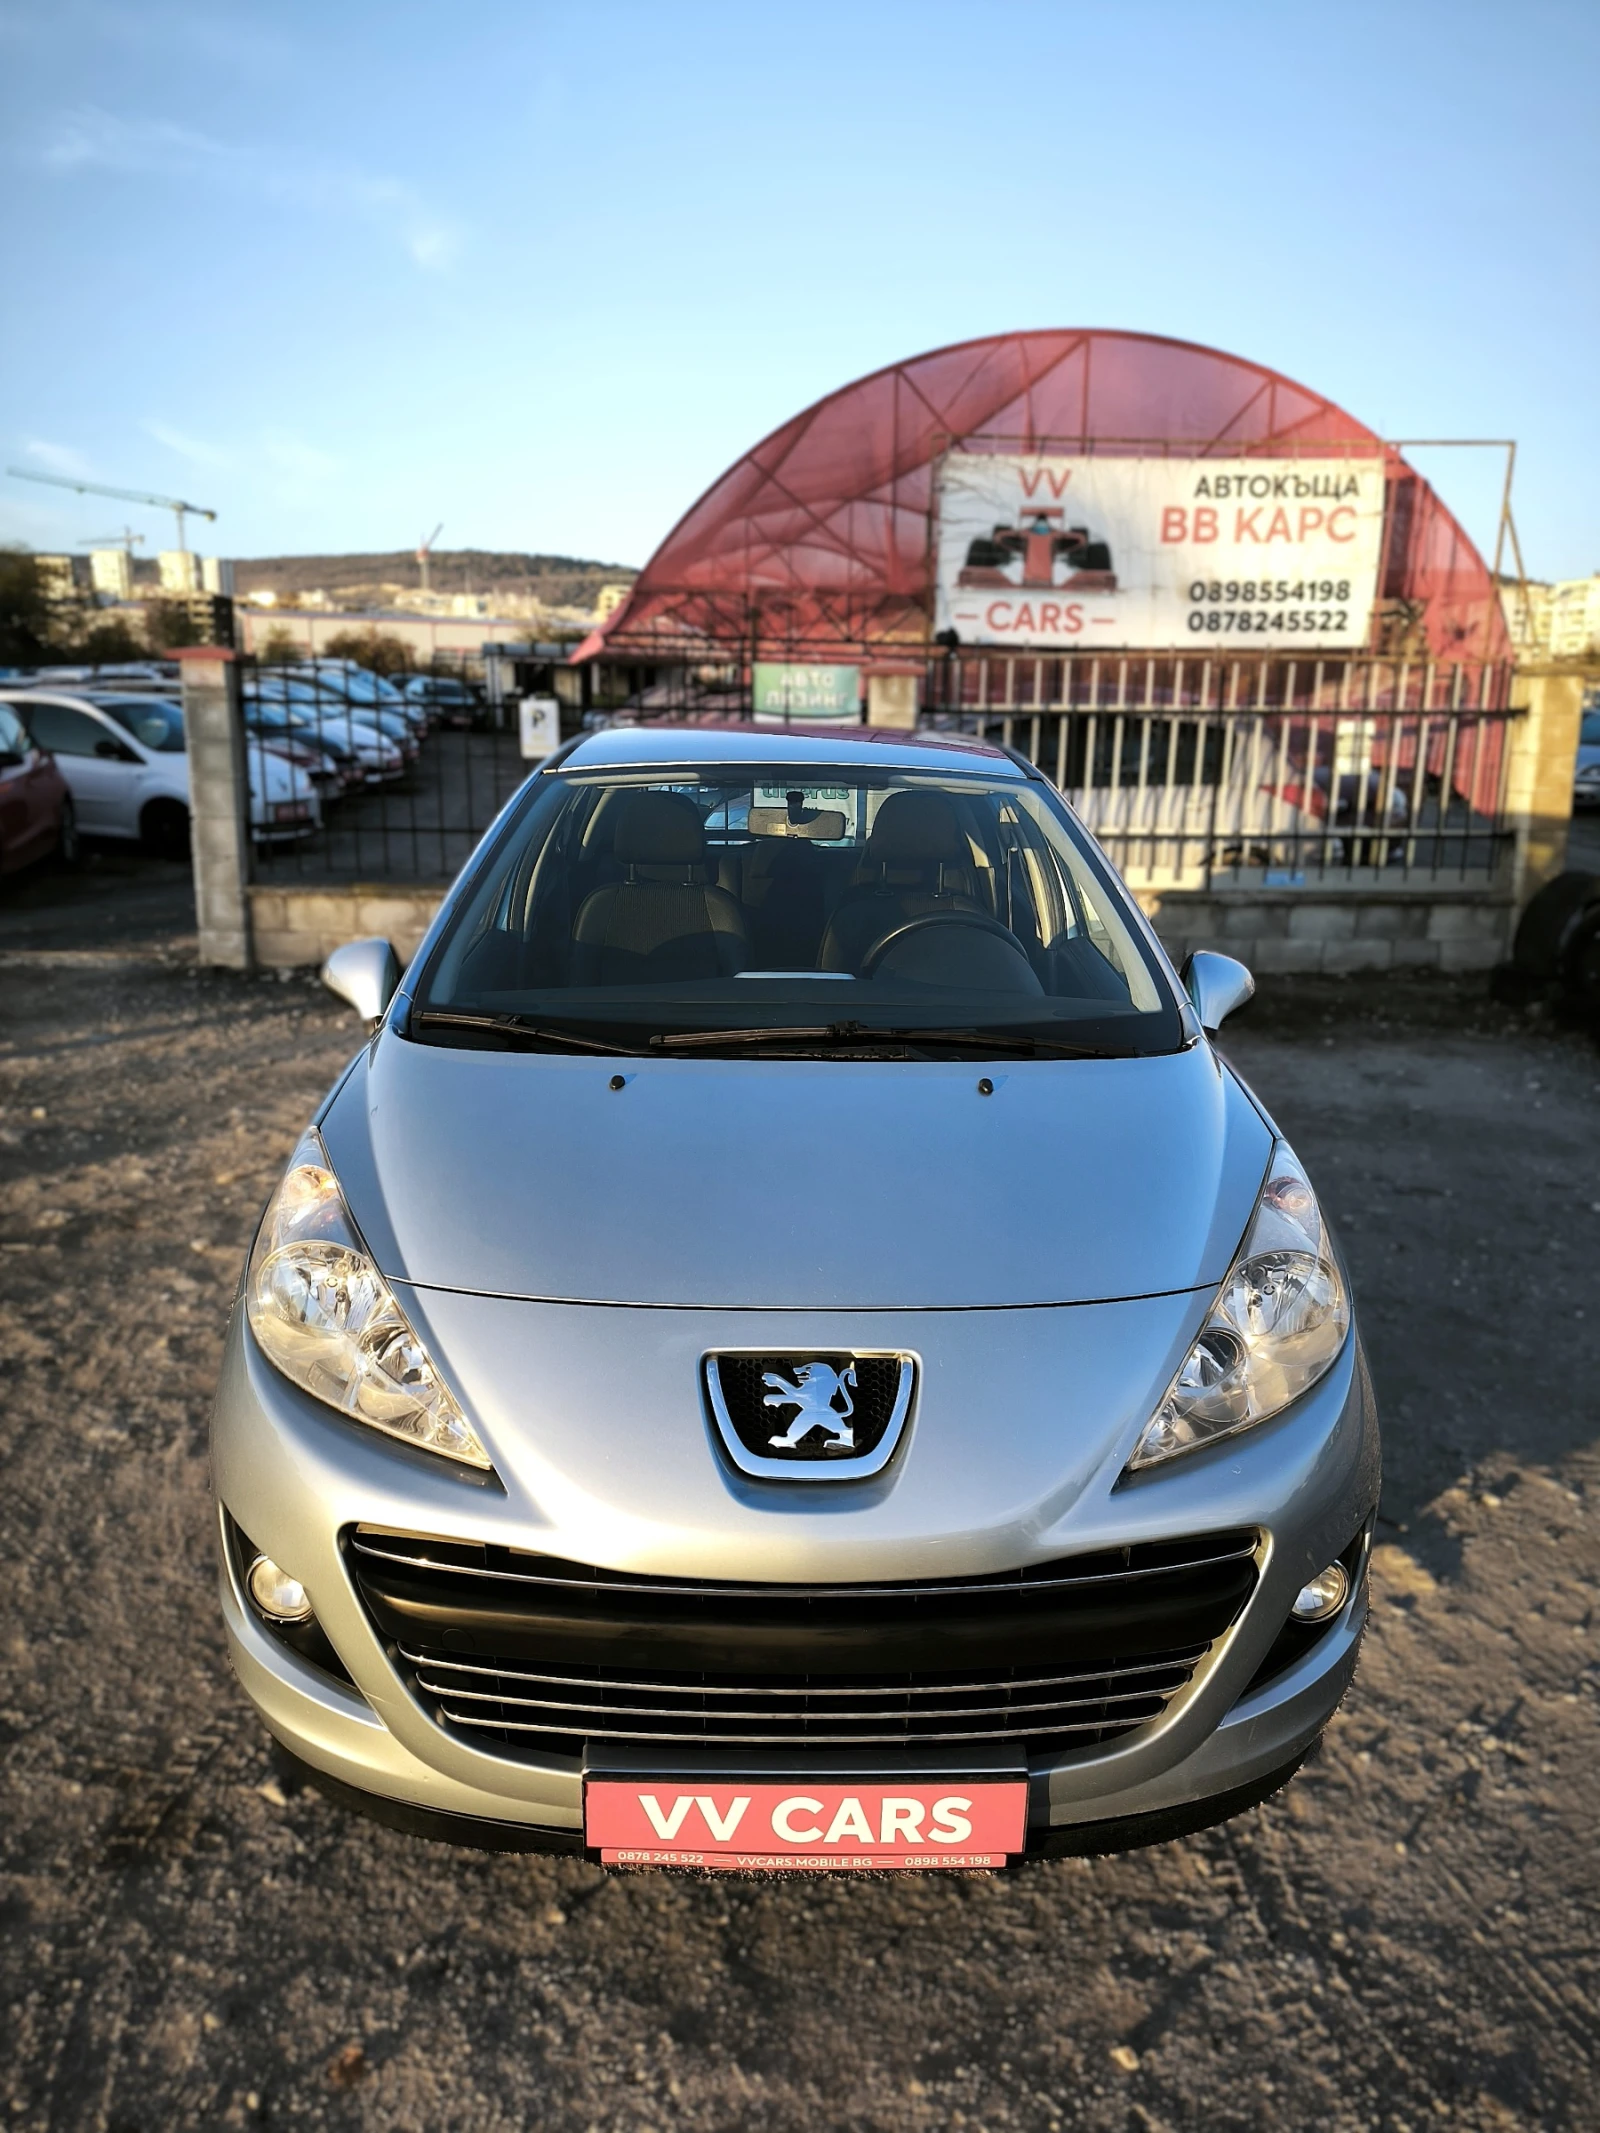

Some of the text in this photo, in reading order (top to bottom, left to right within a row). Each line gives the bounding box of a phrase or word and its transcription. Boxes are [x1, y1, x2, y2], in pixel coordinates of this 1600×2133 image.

[1018, 468, 1072, 500] VV
[1194, 474, 1361, 502] АВТОКЪЩА
[1160, 505, 1357, 544] ВВ КАРС
[1188, 580, 1351, 602] 0898554198
[985, 602, 1084, 634] CARS
[1187, 610, 1349, 632] 0878245522
[637, 1794, 973, 1844] VV CARS
[617, 1851, 992, 1868] 0878 245 522 VVCARS.MOBILE.BG 0898 554 198
